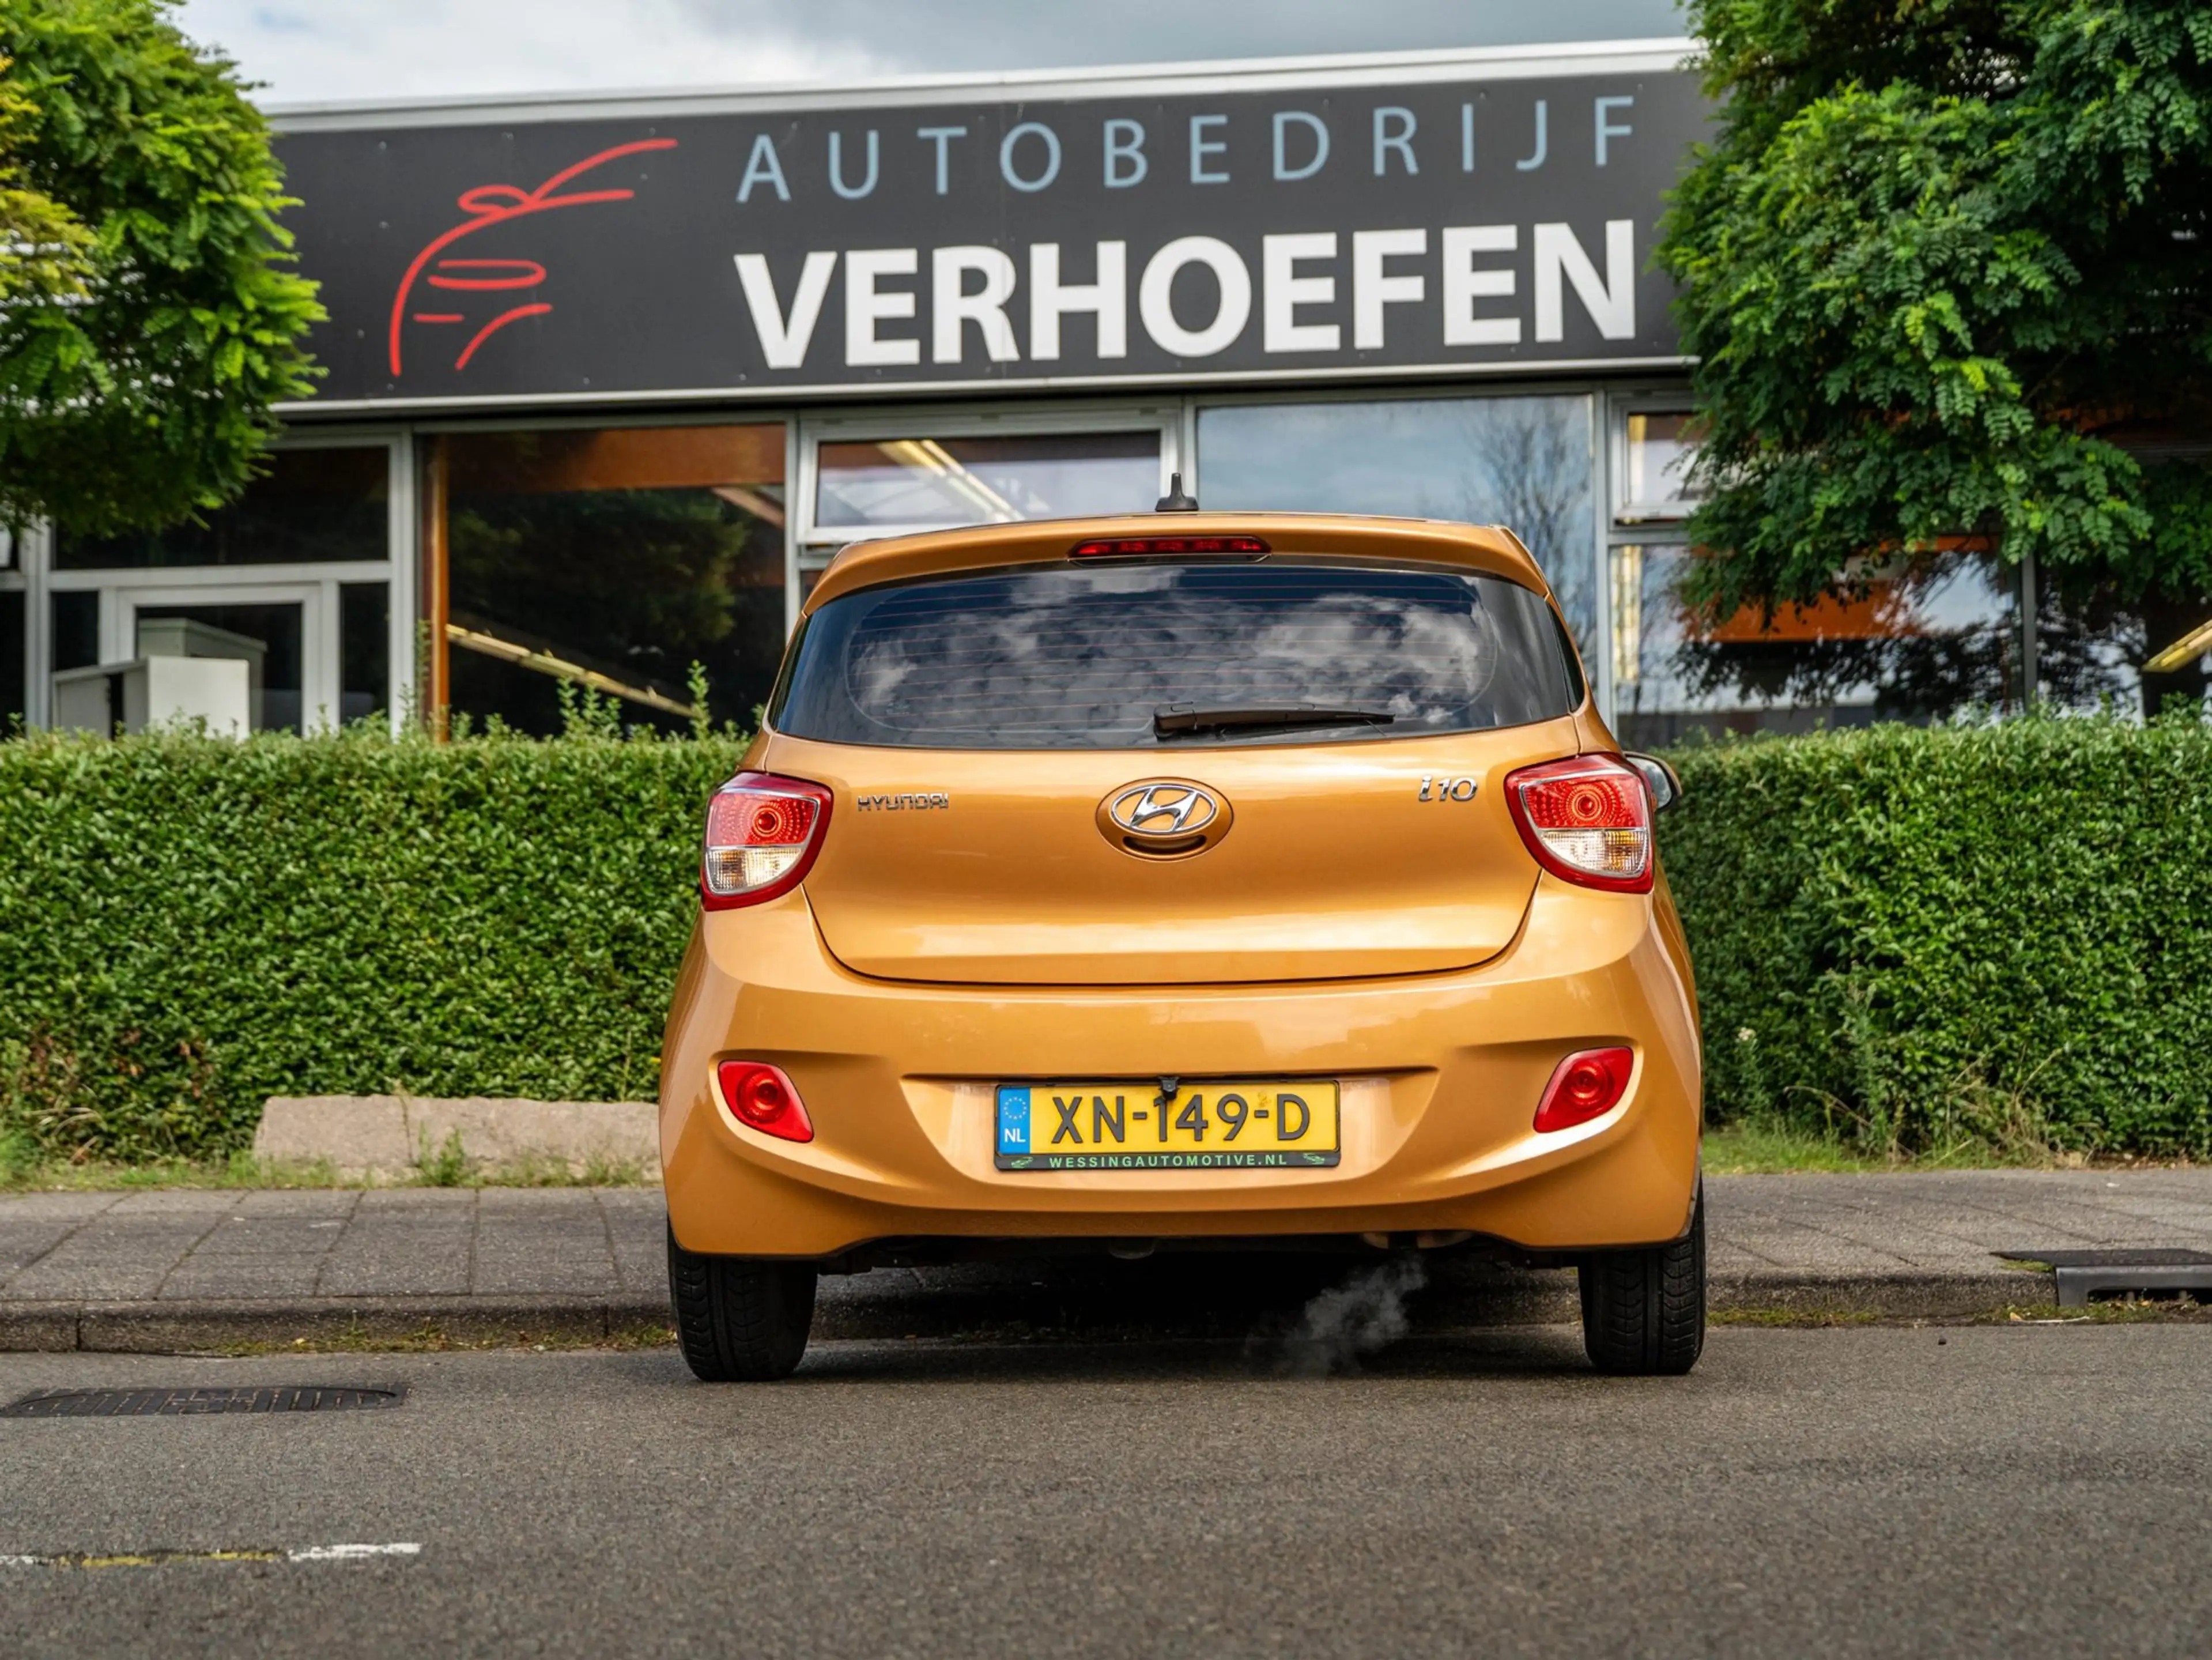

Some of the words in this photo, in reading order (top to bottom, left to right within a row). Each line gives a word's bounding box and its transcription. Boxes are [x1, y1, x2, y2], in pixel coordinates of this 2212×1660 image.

[735, 96, 1635, 203] AUTOBEDRIJF
[733, 219, 1636, 370] VERHOEFEN
[1418, 775, 1478, 802] i10
[858, 793, 949, 812] HYUNDAI
[1051, 1093, 1310, 1144] XN-149-D
[1004, 1128, 1026, 1143] NL
[1049, 1155, 1287, 1168] WESSINGAUTOMOTIVE.NL
